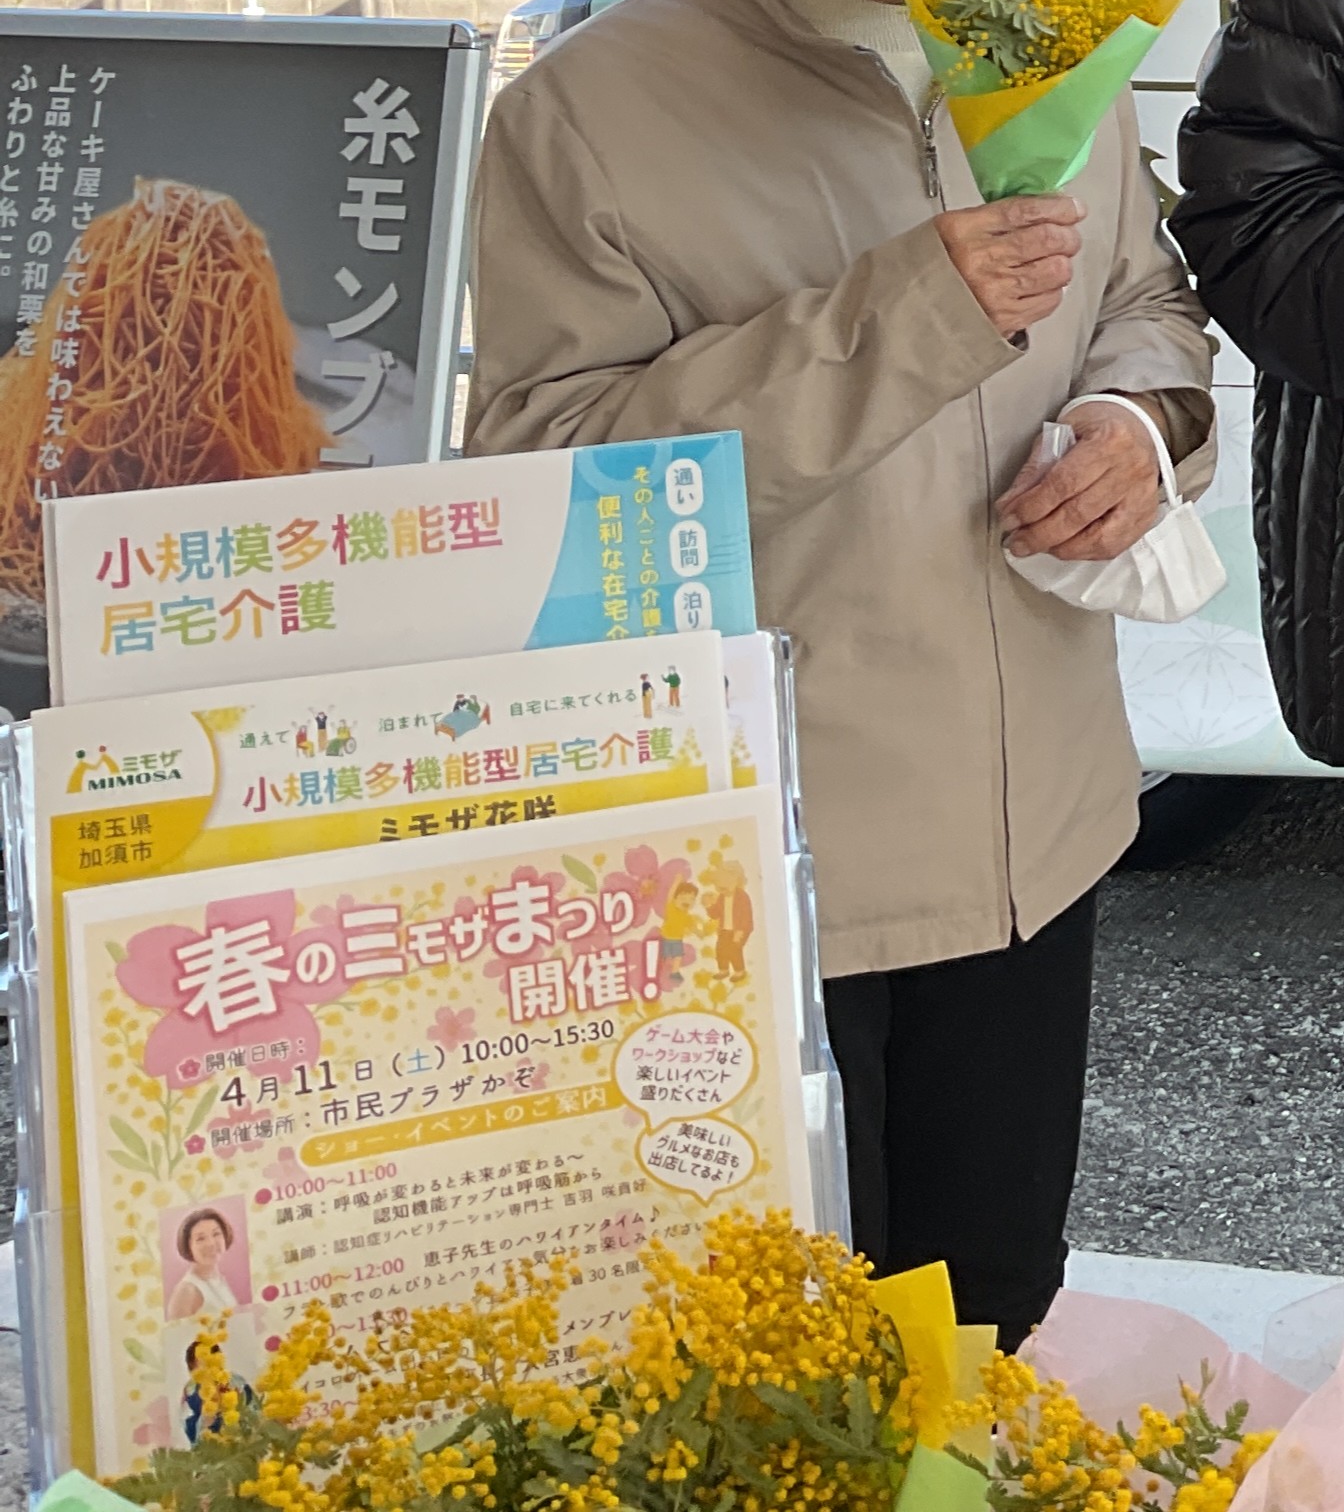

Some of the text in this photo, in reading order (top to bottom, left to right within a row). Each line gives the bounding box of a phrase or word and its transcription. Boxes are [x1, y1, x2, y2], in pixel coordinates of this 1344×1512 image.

[15, 64, 76, 356] 上品な甘みの和栗を
[34, 66, 116, 502] ケーキ屋さんでは味わえない
[674, 467, 694, 504] 通い
[96, 497, 503, 589] 小規模多機能型
[678, 530, 699, 568] 訪問
[100, 581, 337, 656] 居宅介護
[683, 591, 702, 629] 泊り
[510, 689, 637, 717] 自宅に来てくれる
[379, 712, 444, 733] 泊まれて
[240, 729, 290, 749] 通えて
[122, 749, 183, 772] ミモザ
[243, 727, 673, 813] 小規模多機能型居宅介護
[87, 769, 183, 791] MIMOSA
[78, 813, 152, 842] 埼玉県
[79, 840, 152, 870] 加須市
[646, 1024, 734, 1045] ゲーム大会や
[632, 1048, 742, 1065] ワークショップなど
[636, 1065, 731, 1083] 楽しいイベント
[322, 1065, 534, 1125] 市民プラザかぞ
[640, 1084, 722, 1103] 盛りだくさん
[677, 1123, 731, 1147] 美味しい
[656, 1135, 739, 1168] グルメなお店も
